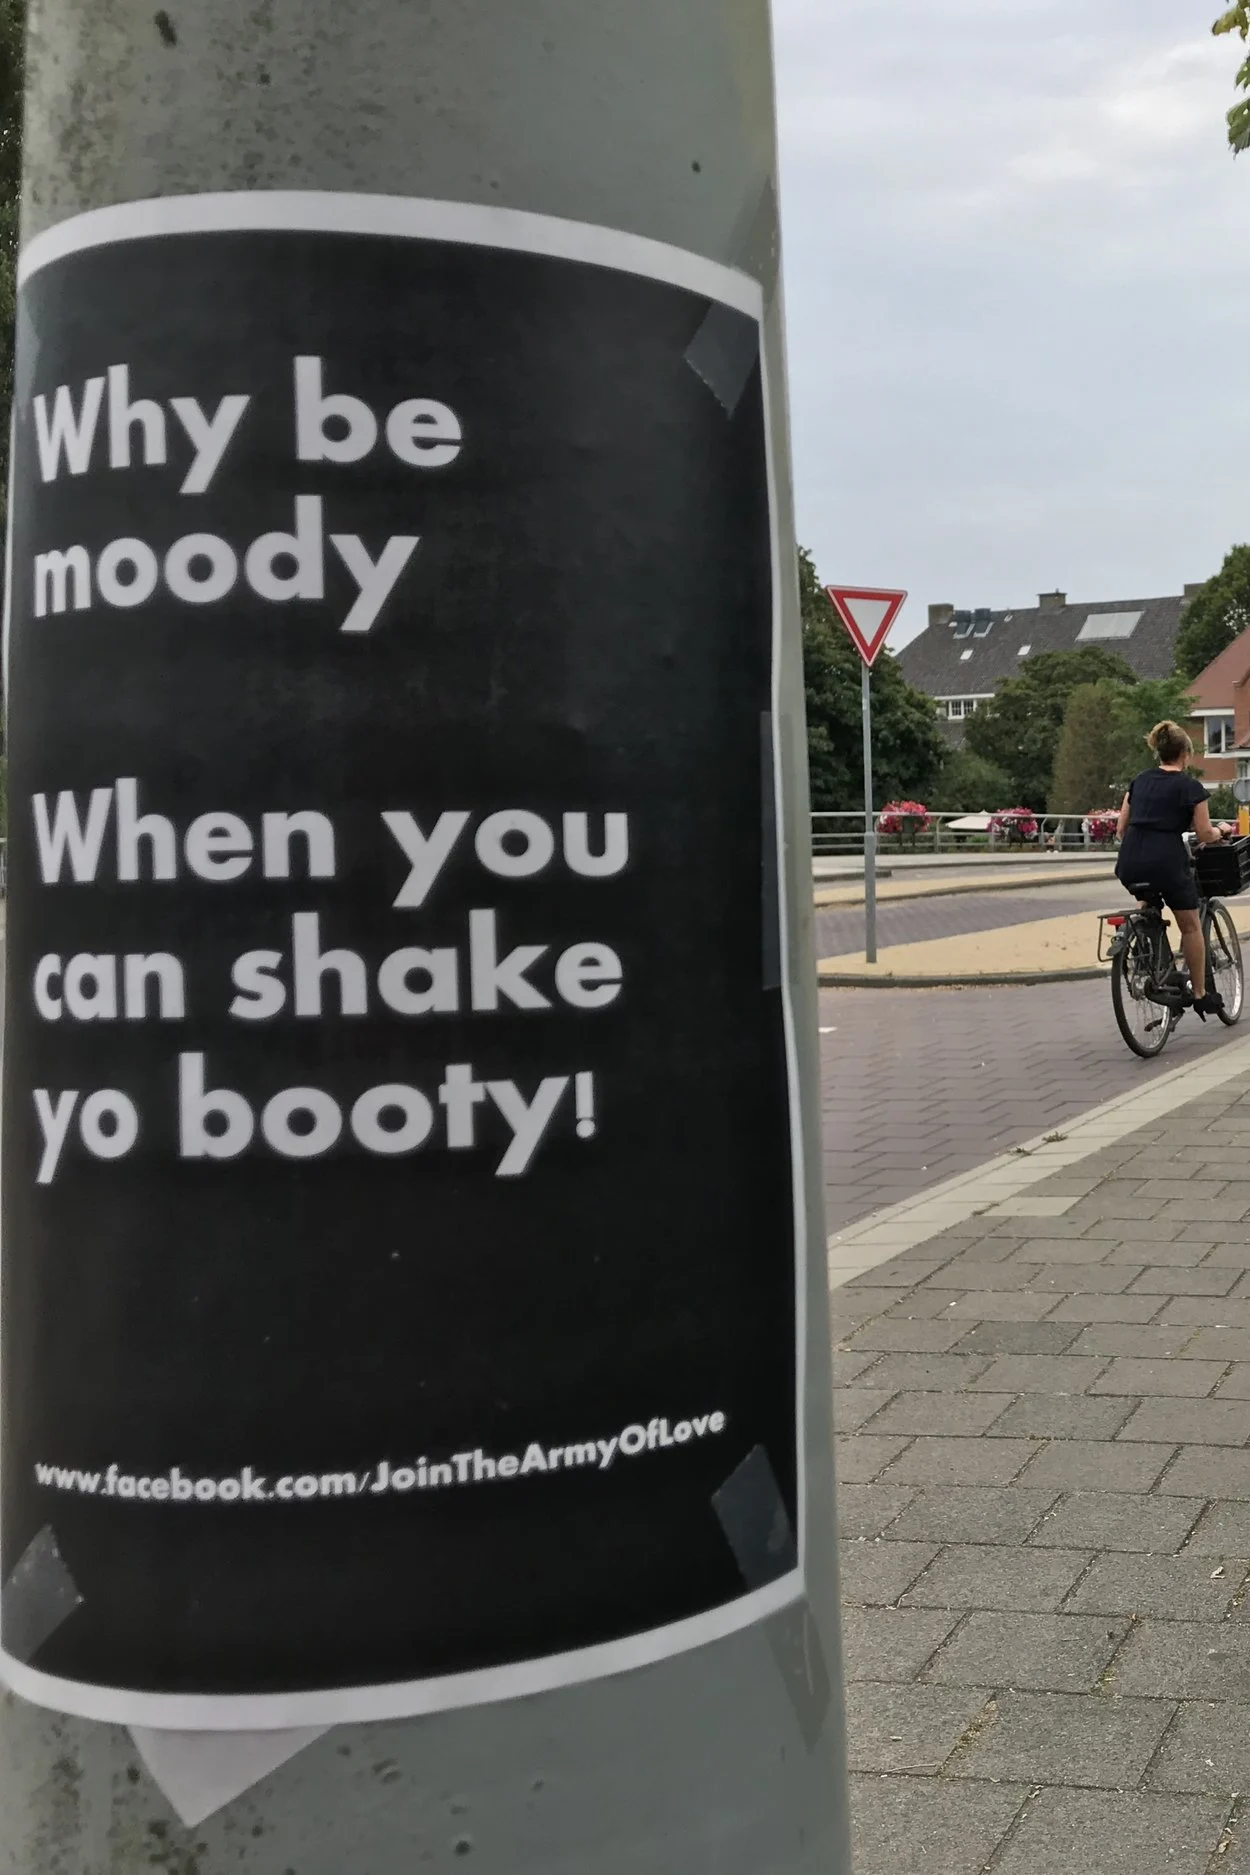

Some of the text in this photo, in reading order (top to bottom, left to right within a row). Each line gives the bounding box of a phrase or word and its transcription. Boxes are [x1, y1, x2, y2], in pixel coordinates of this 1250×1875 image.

[33, 356, 462, 494] Why be
[33, 495, 420, 632] moody
[32, 778, 629, 907] When you
[33, 908, 623, 1021] can shake
[33, 1052, 596, 1184] yo booty!
[35, 1409, 726, 1502] www.facebook.com/JoinTheArmyOfLove
